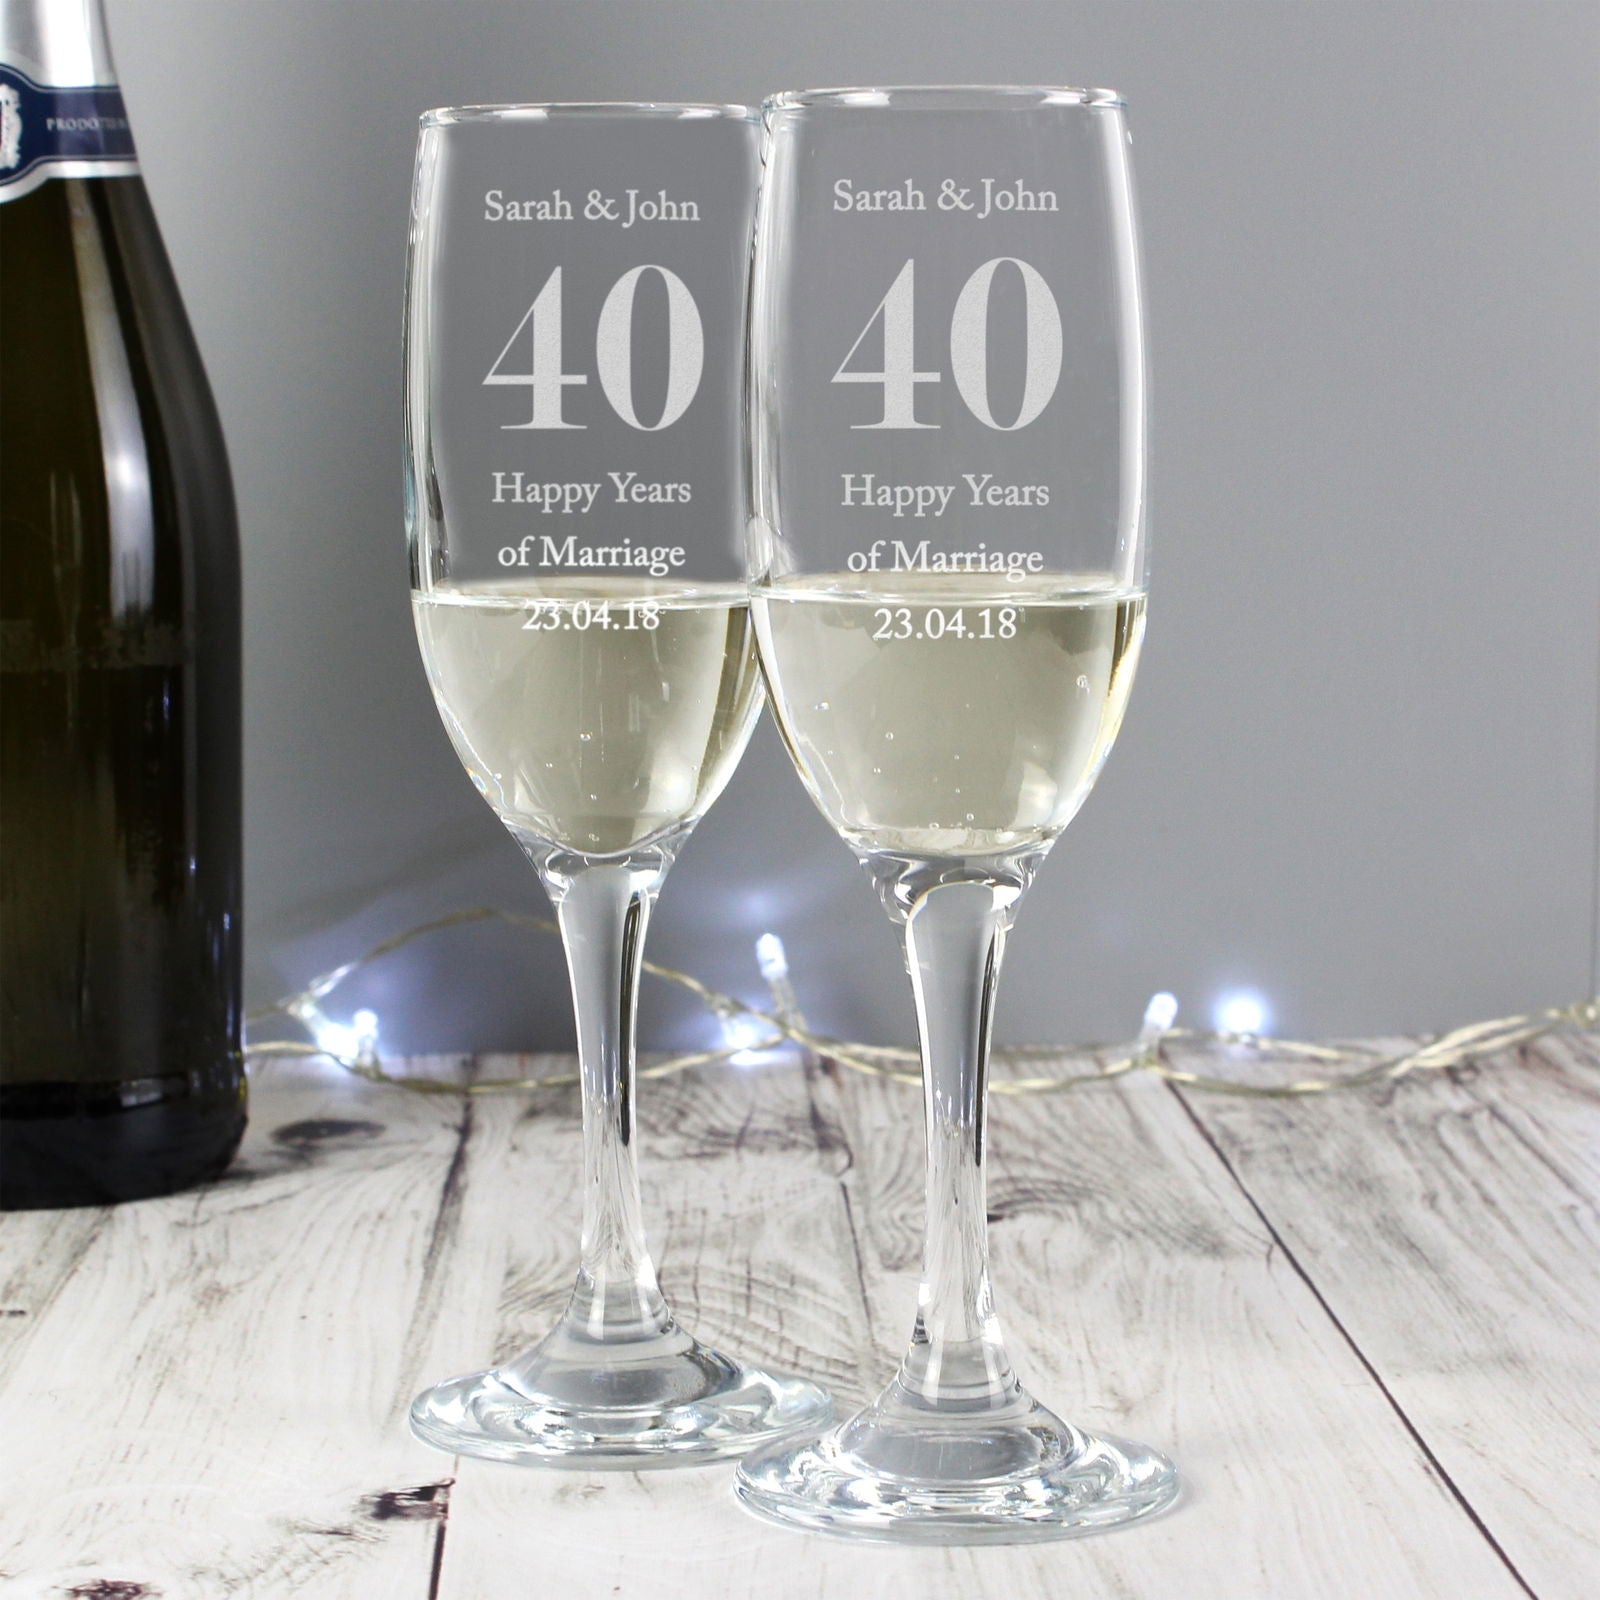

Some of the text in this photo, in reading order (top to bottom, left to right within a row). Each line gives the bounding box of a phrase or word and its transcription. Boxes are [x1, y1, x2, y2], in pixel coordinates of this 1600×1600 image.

[484, 190, 701, 228] Sarah & John
[832, 178, 1059, 219] Sarah & John
[481, 264, 704, 431] 40
[830, 257, 1063, 431] 40
[491, 472, 692, 513] Happy Years
[841, 474, 1050, 517] Happy Years
[498, 536, 686, 576] of Marriage
[847, 540, 1044, 582] of Marriage
[522, 600, 660, 630] 23.04.18
[873, 608, 1017, 639] 23.04.18
